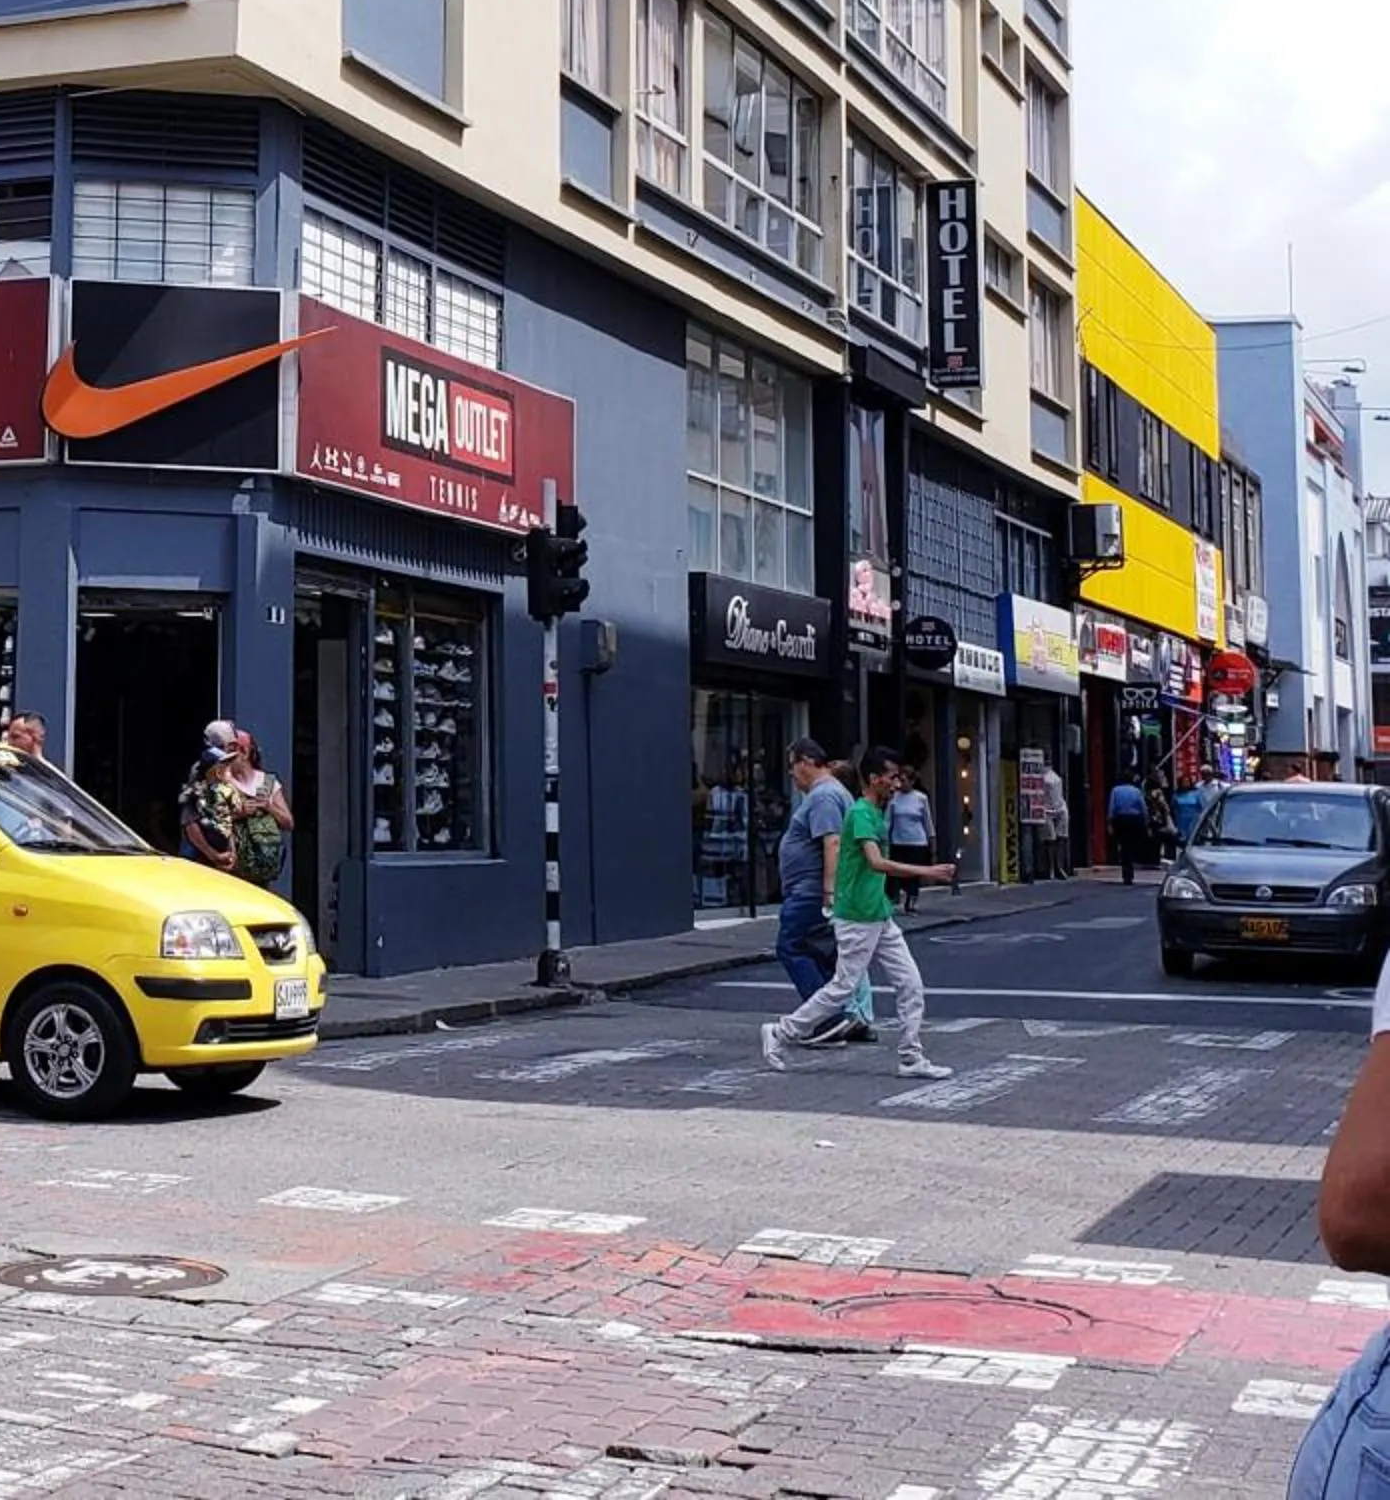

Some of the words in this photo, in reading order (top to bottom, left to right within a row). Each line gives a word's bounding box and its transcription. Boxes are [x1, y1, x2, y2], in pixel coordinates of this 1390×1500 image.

[938, 187, 968, 353] HOTEL
[385, 360, 450, 455] MEGA
[454, 396, 508, 462] OUTLET
[429, 475, 478, 513] TENNIS
[905, 633, 952, 646] HOTEL
